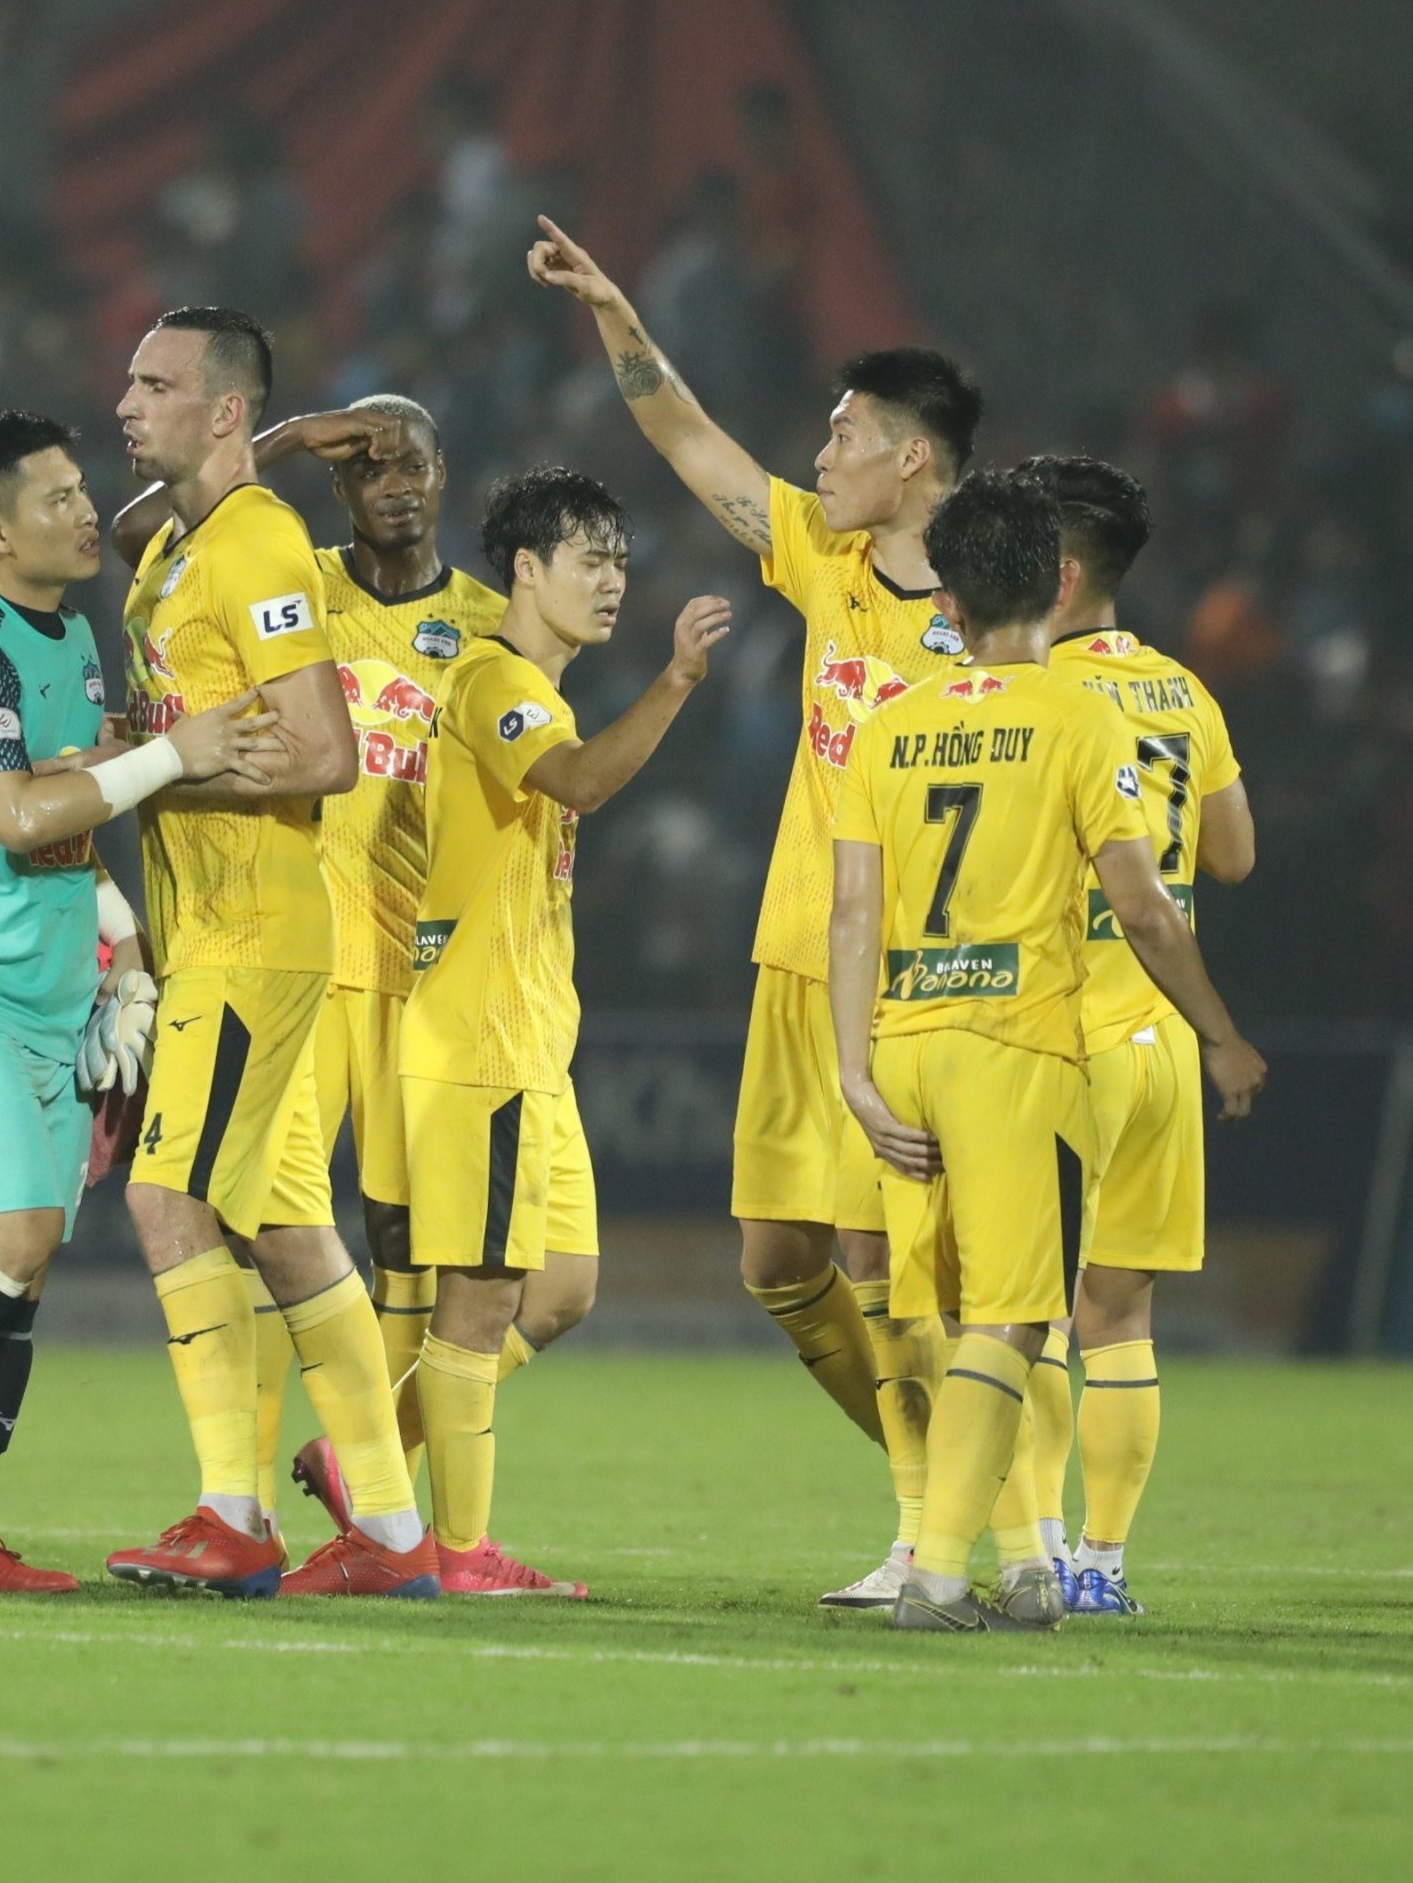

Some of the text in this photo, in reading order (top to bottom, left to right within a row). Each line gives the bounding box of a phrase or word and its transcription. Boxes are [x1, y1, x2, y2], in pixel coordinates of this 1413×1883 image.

[263, 604, 299, 633] LS
[503, 717, 518, 735] LS
[990, 727, 1034, 762] DUY
[924, 783, 984, 937] 7
[143, 1112, 163, 1155] 4
